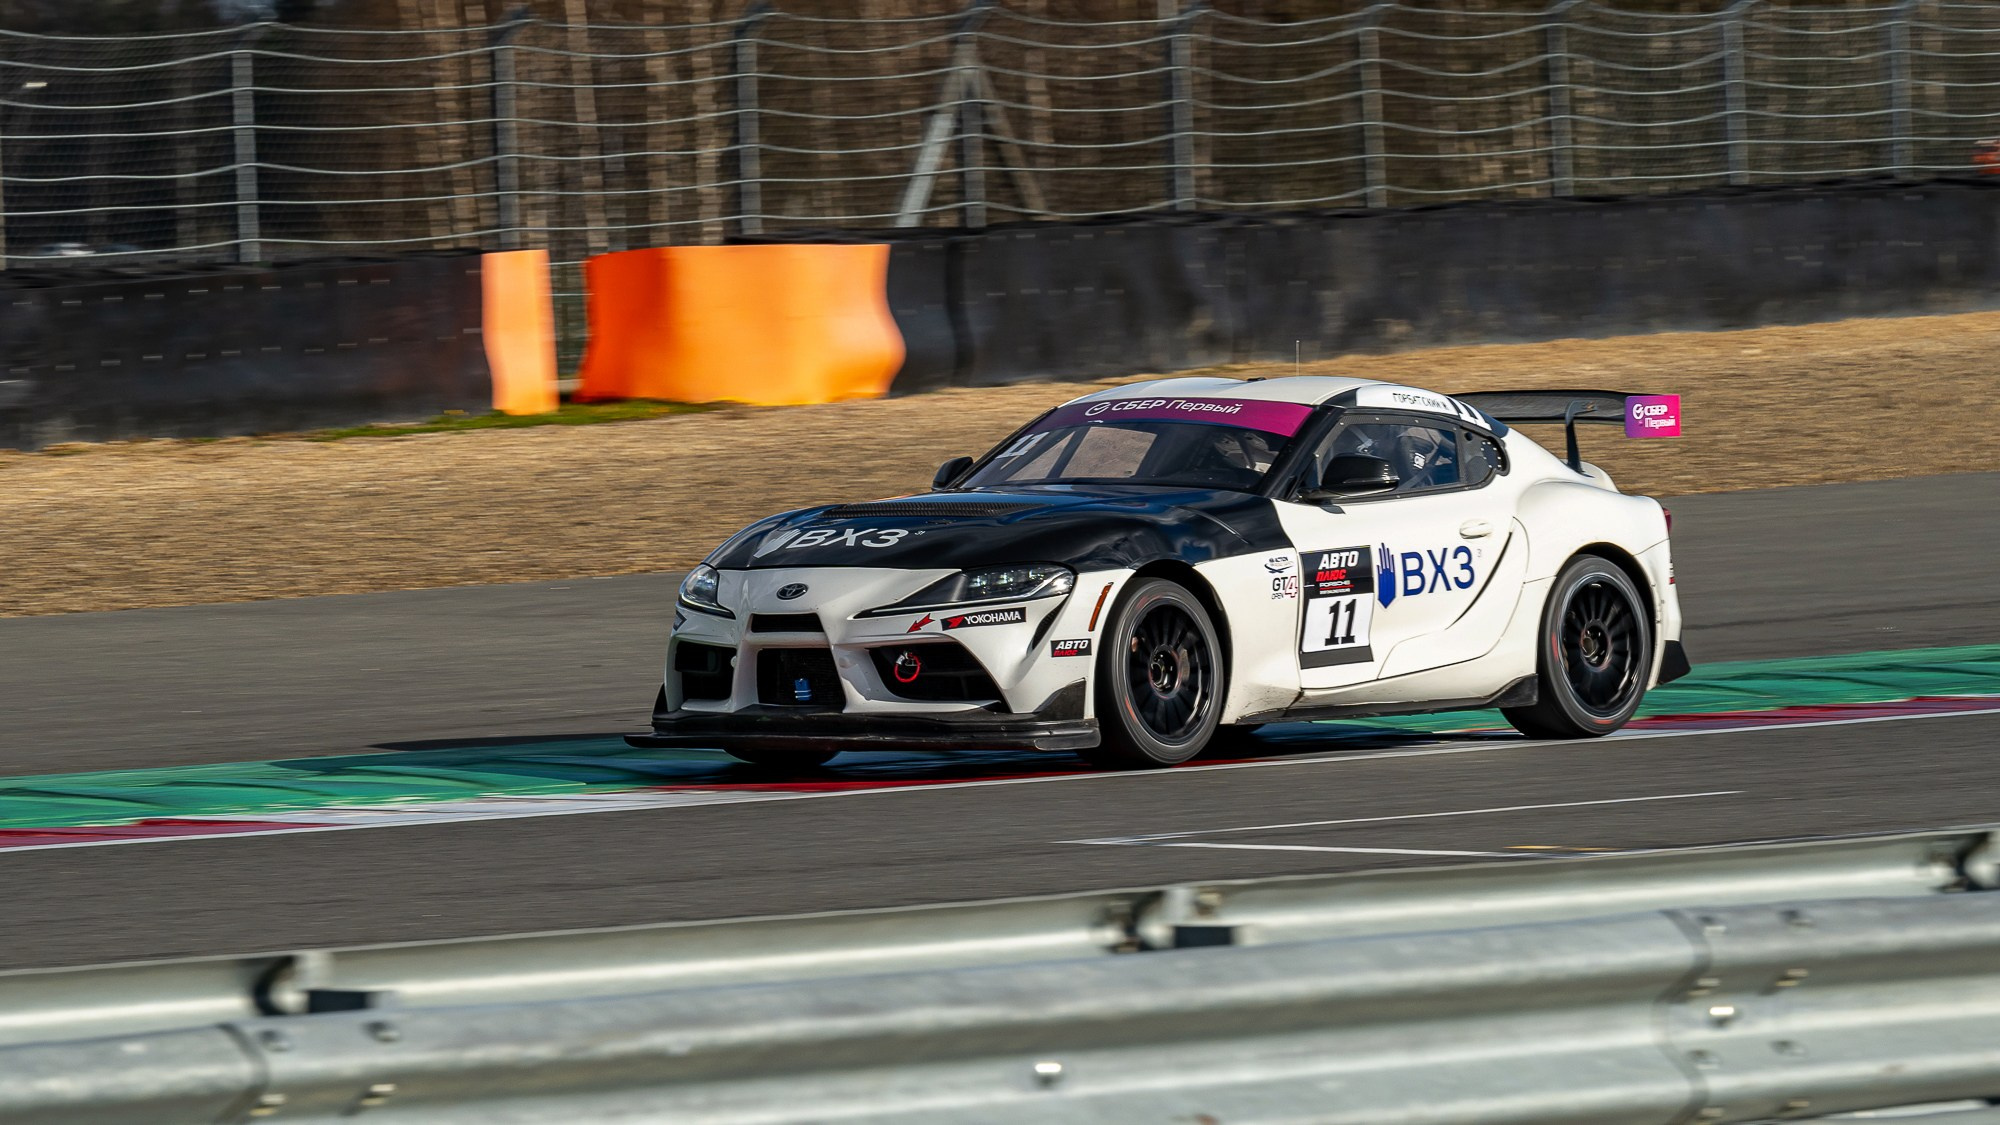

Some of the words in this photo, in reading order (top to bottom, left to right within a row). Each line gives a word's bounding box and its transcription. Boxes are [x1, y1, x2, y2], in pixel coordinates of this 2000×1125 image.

[1111, 399, 1166, 411] СБЕР
[1166, 399, 1244, 414] Первый
[1318, 550, 1359, 570] АВТО
[1315, 569, 1347, 582] ПЛЮС
[1400, 545, 1475, 597] BX3
[1272, 575, 1298, 599] GT4
[964, 610, 1021, 625] YOKOHAMA
[1324, 598, 1357, 646] 11
[1055, 639, 1089, 650] АВТО
